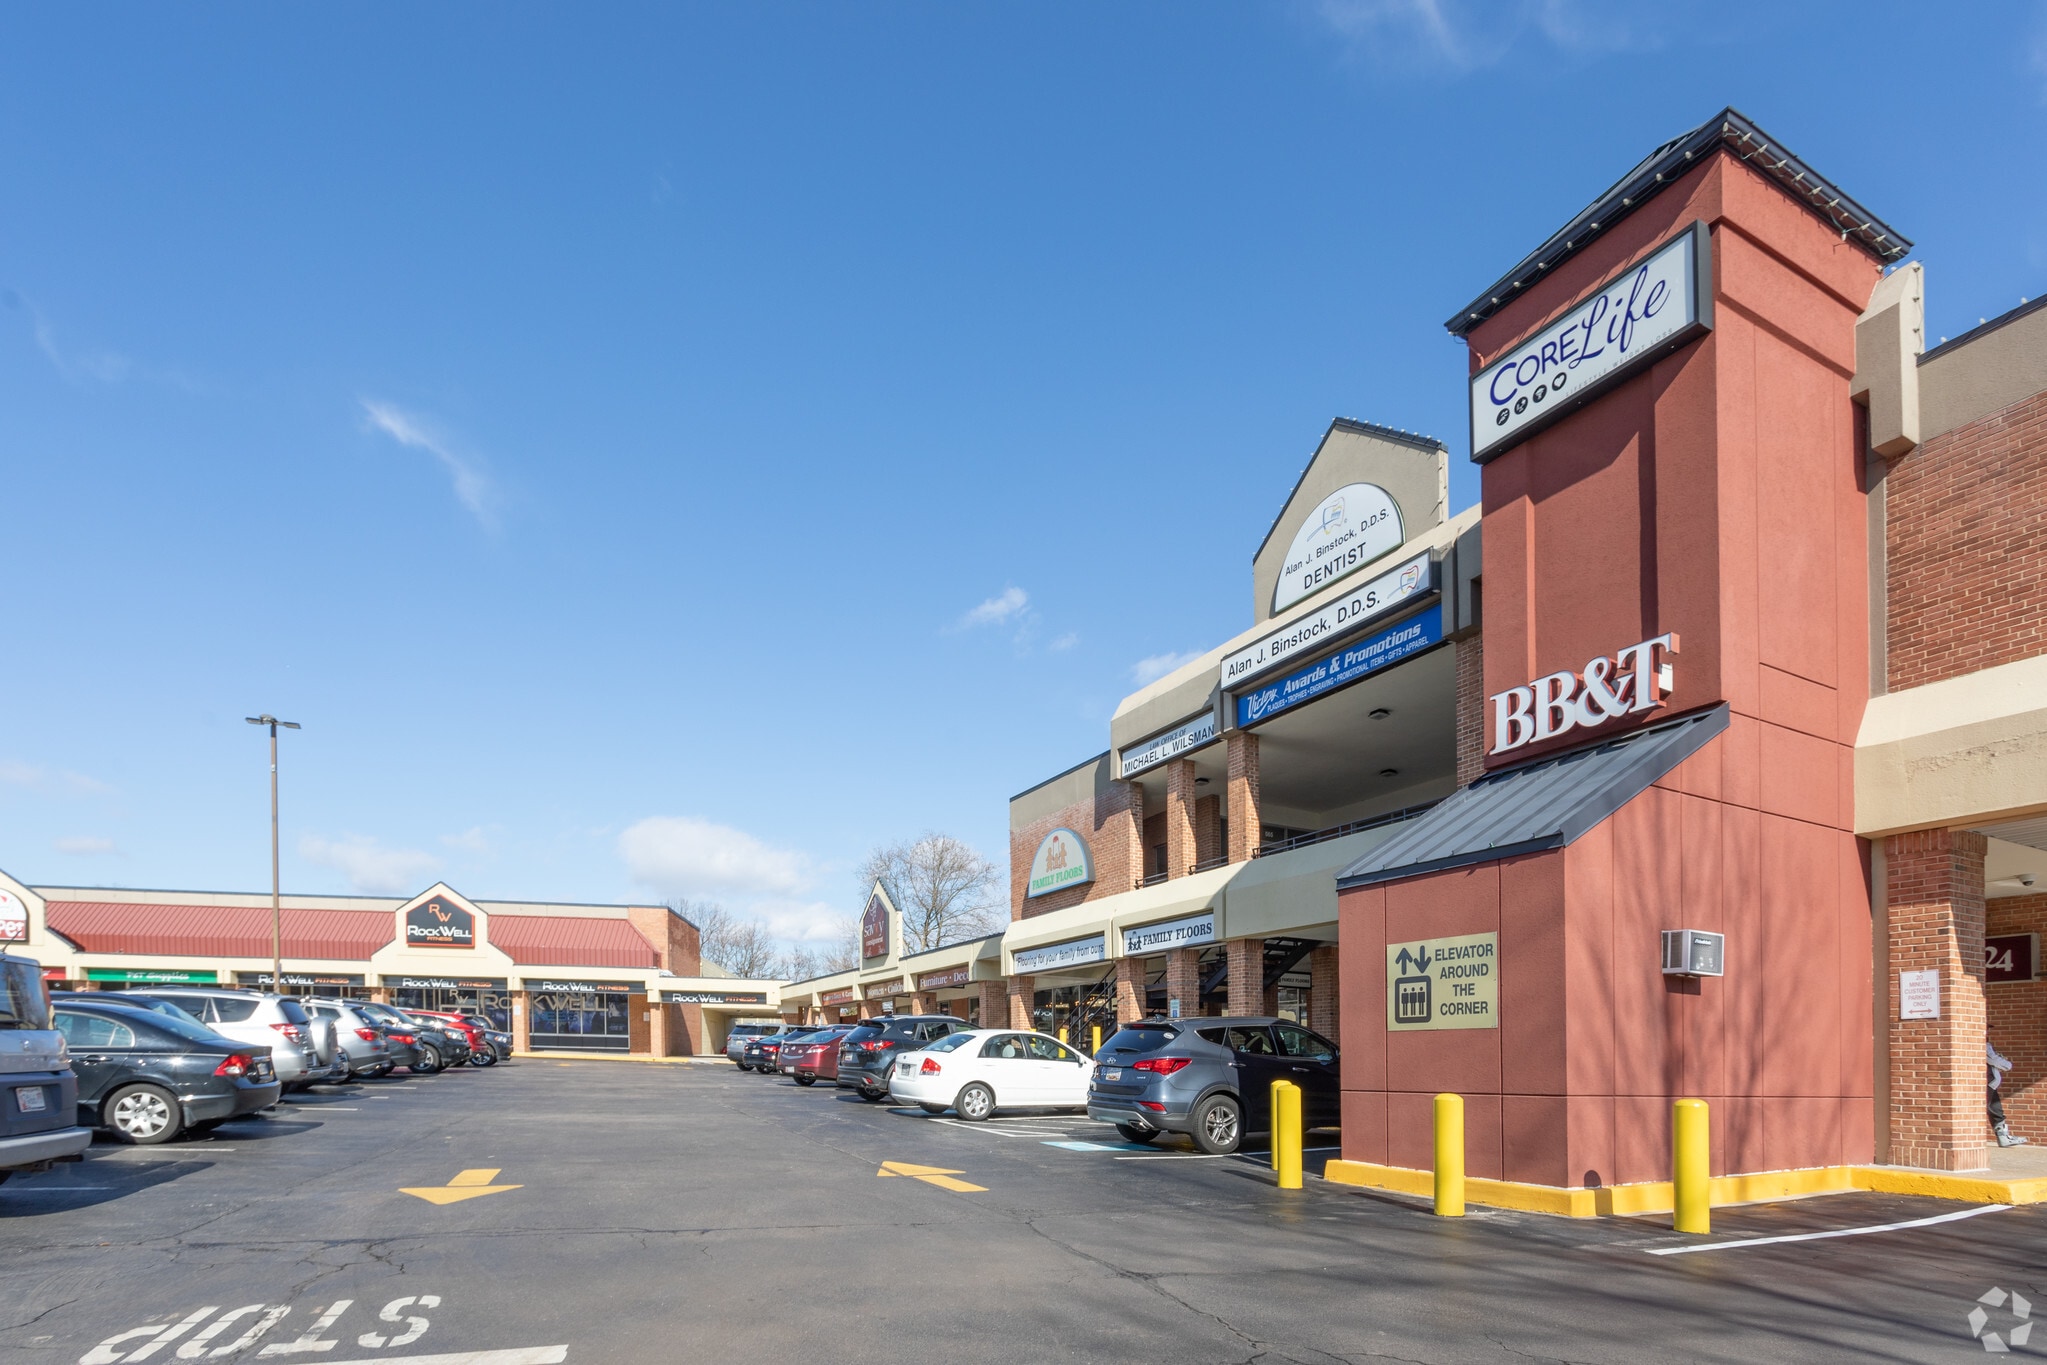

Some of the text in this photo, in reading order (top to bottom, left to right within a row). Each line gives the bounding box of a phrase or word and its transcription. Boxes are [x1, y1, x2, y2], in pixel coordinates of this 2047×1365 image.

[1285, 508, 1390, 576] Alan J. Binstock, D.D.S.
[1304, 542, 1367, 589] DENTIST
[1228, 590, 1381, 679] Alan J. Binstock, D.D.S.
[1247, 623, 1422, 719] Victory Awards & Promotions
[1267, 635, 1429, 712] PLAQUES TROPHIES ENGRAVING PROMOTIONAL ITEMS GIFTS APPAREL
[1489, 632, 1680, 756] BB&T
[1124, 724, 1215, 773] MICHAEL L. WILSMAN
[1161, 732, 1178, 746] OFFICE
[1179, 727, 1187, 737] OF
[1032, 864, 1083, 890] FAMILY FLOORS
[1143, 922, 1213, 945] FAMILY FLOORS
[1435, 943, 1494, 961] ELEVATOR
[920, 975, 948, 988] Furniture
[1439, 963, 1489, 980] AROUND
[1452, 983, 1476, 996] THE
[1904, 987, 1936, 995] CUSTOMER
[1440, 1001, 1489, 1016] CORNER
[78, 1295, 441, 1365] STOP
